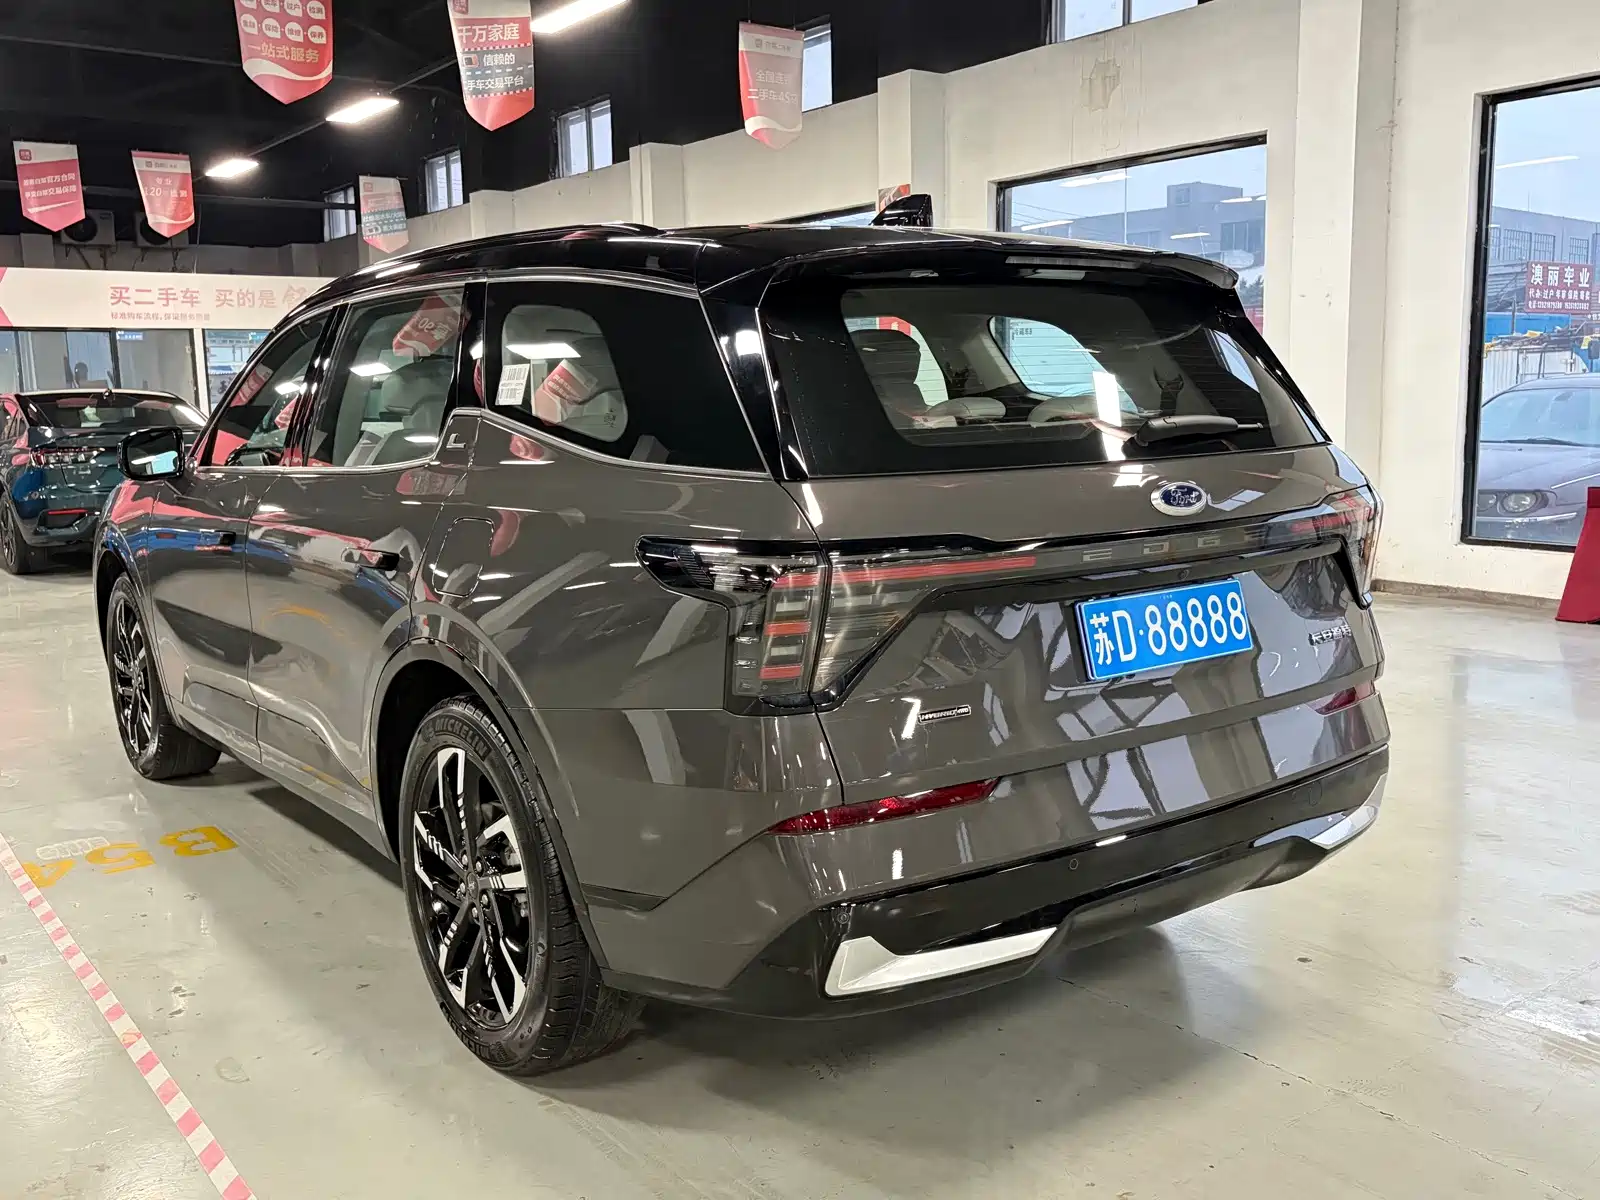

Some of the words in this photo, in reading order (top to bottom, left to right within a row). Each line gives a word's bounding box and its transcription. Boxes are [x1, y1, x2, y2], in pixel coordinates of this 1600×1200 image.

[457, 23, 520, 44] 千万家庭
[248, 42, 319, 63] 一站式服务
[483, 52, 516, 67] 信赖的
[1530, 263, 1590, 288] 澳丽车业
[110, 286, 201, 308] 买二手车
[1083, 528, 1266, 562] EDGE
[1089, 590, 1248, 667] 苏D·88888
[435, 717, 489, 759] MICHELIN
